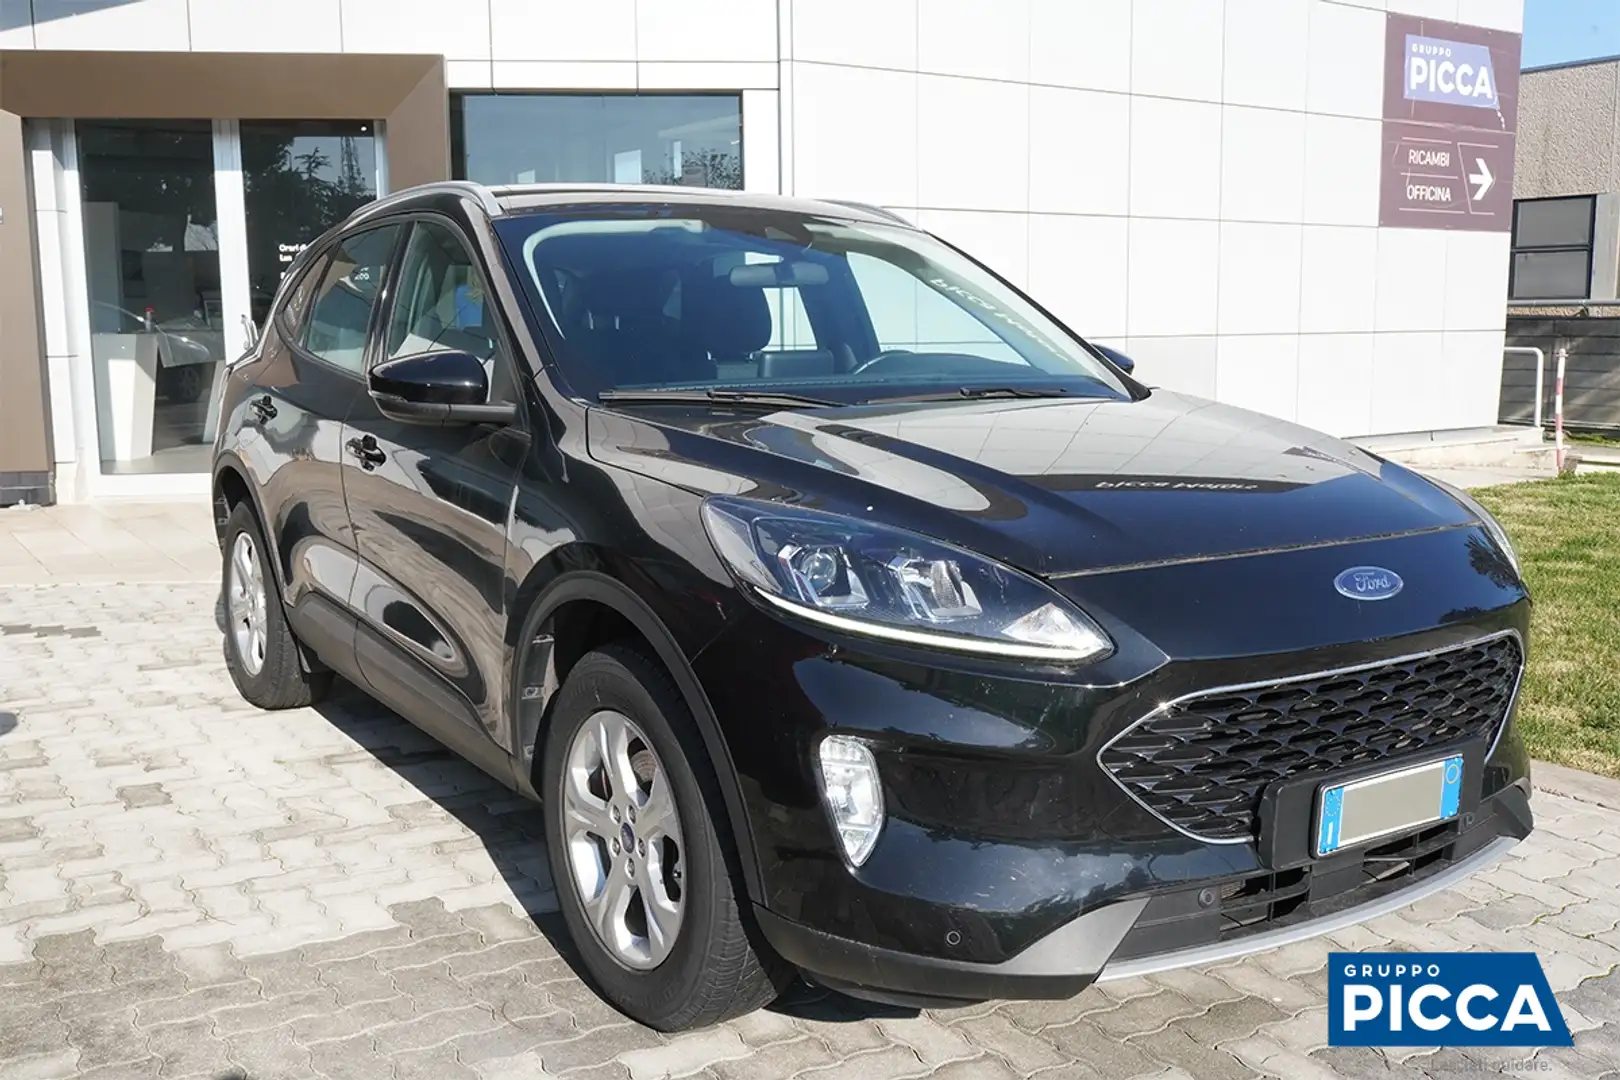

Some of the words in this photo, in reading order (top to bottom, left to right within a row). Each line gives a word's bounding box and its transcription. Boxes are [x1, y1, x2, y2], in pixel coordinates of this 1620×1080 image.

[1411, 43, 1452, 57] GRUPPO
[1410, 57, 1493, 99] PICCA
[1408, 149, 1450, 167] RICAMBI
[1406, 184, 1452, 201] OFFICINA
[1353, 571, 1392, 592] Ford
